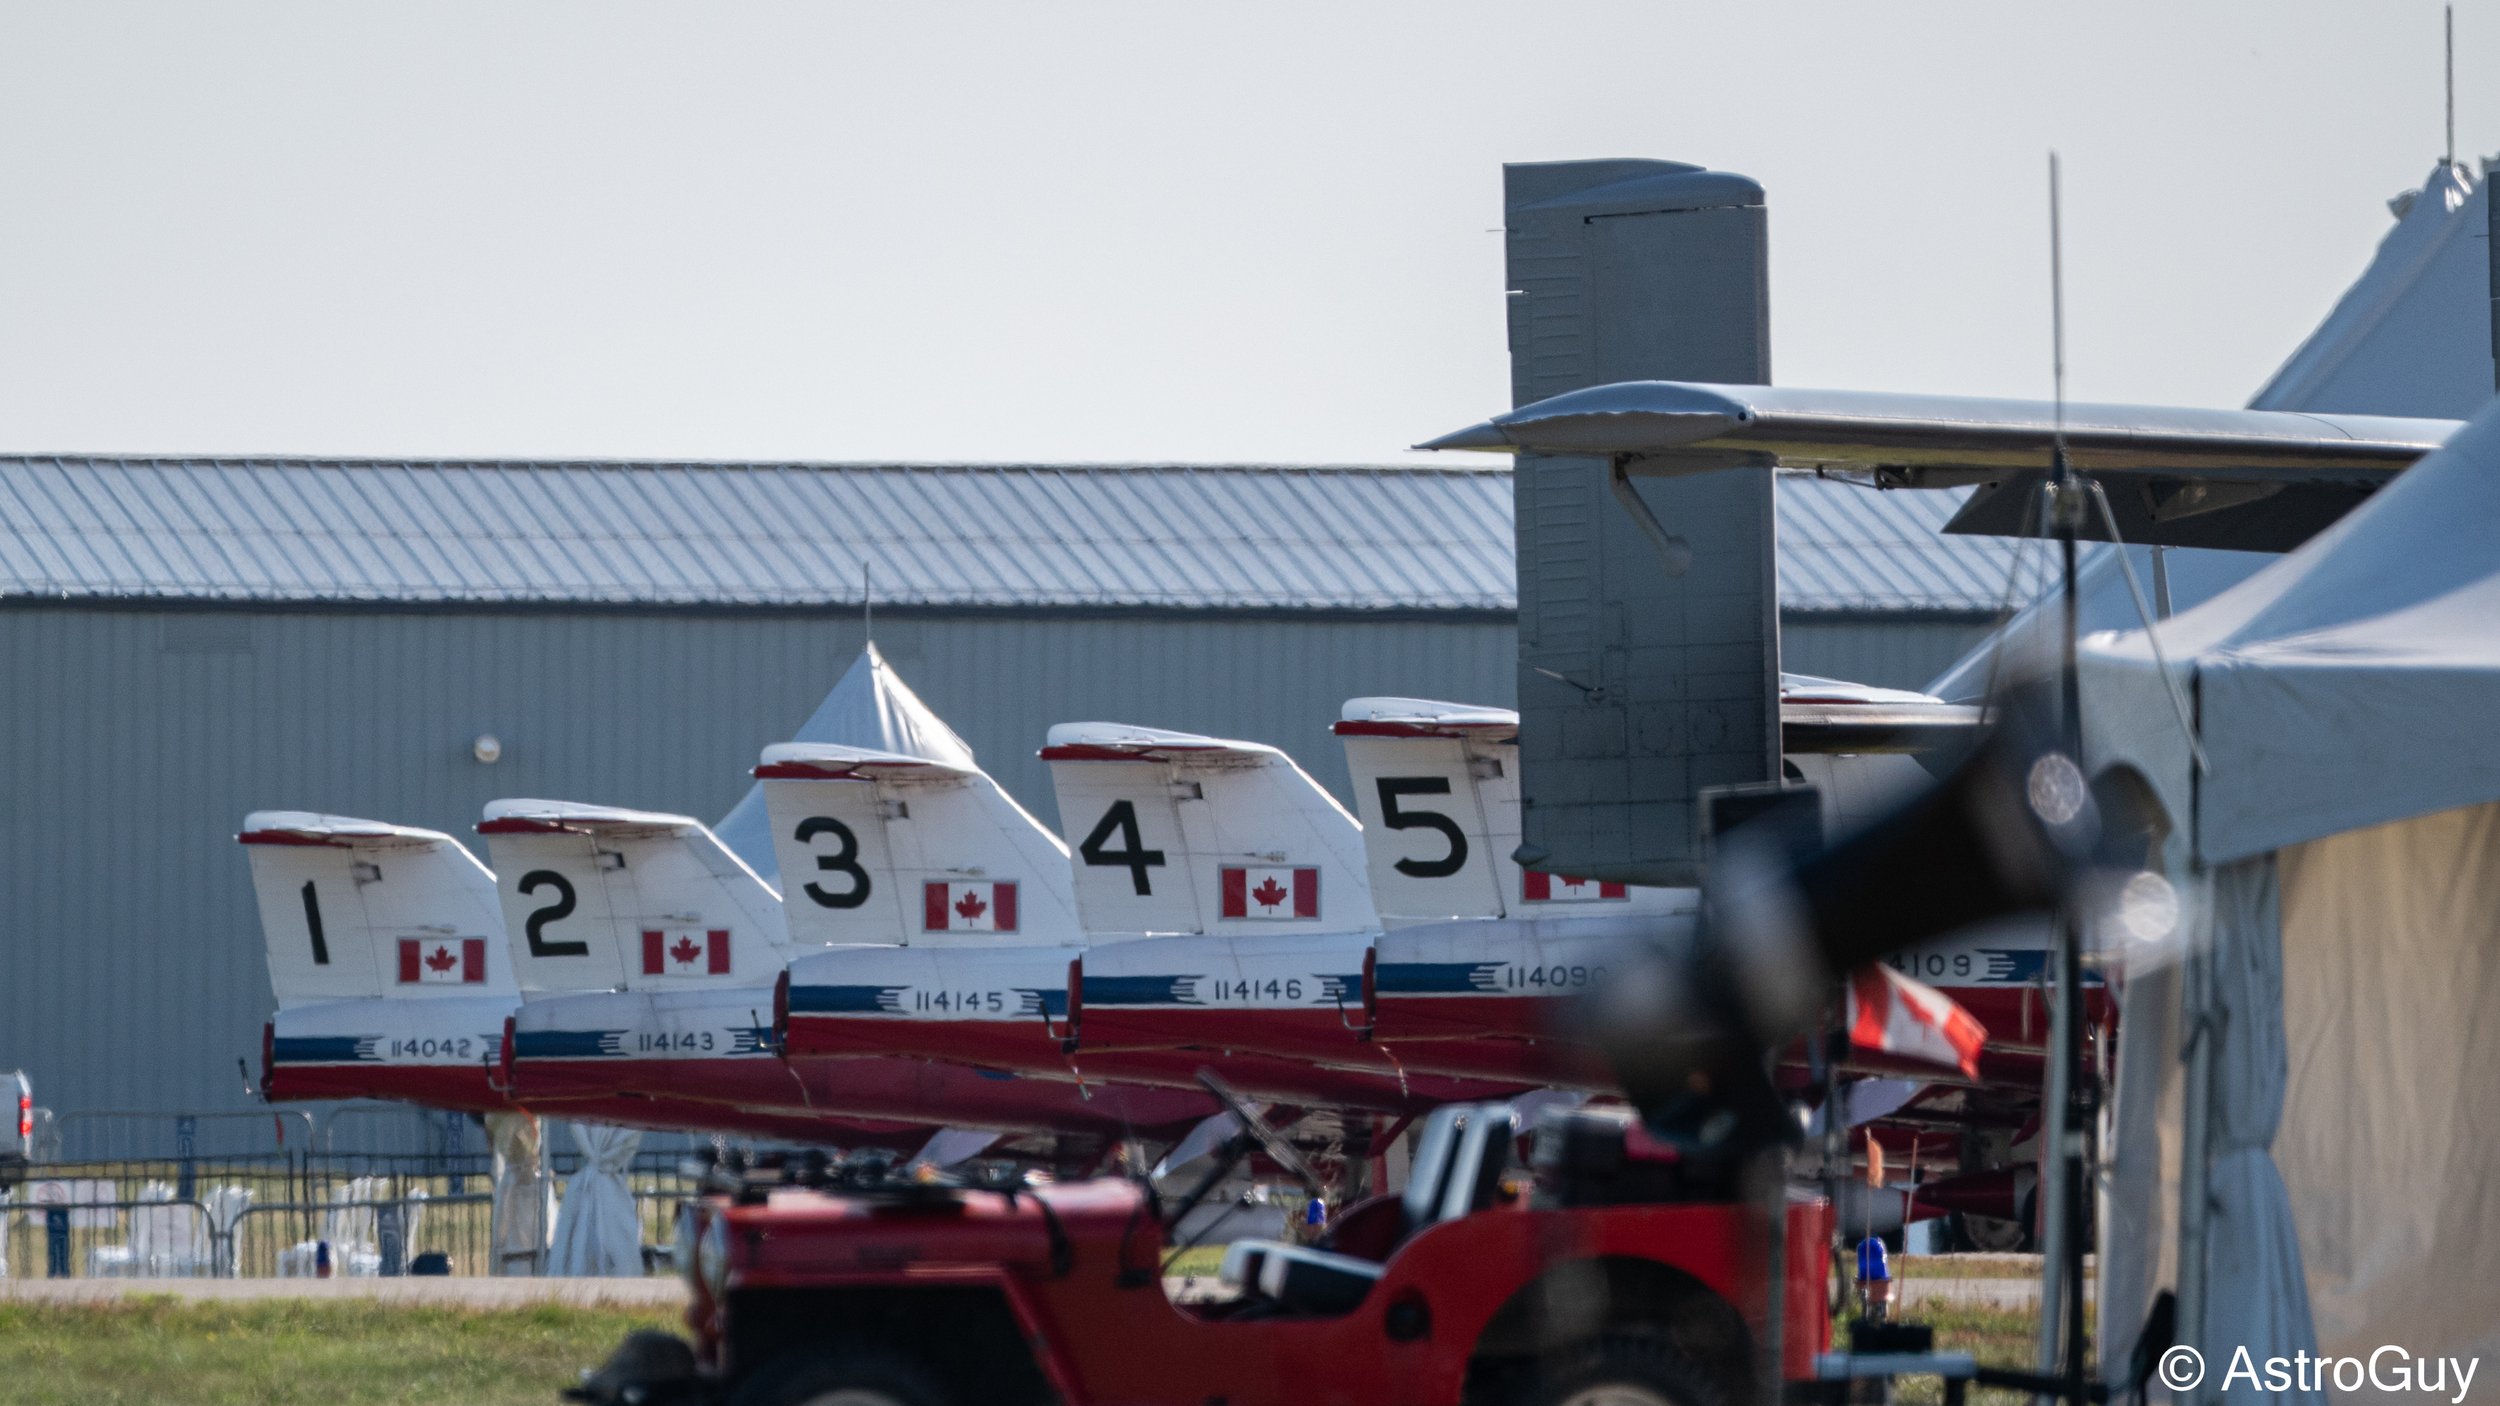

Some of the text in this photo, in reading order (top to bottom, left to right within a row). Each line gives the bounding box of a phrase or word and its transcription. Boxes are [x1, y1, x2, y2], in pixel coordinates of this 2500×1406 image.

[794, 816, 871, 909] 3
[1079, 799, 1166, 896] 4
[1375, 776, 1468, 878] 5
[302, 880, 329, 965] 1
[518, 870, 589, 957] 2
[916, 990, 1003, 1012] 114145
[1215, 979, 1302, 1000] 114146
[391, 1038, 472, 1058] 114042
[639, 1031, 714, 1052] 114143
